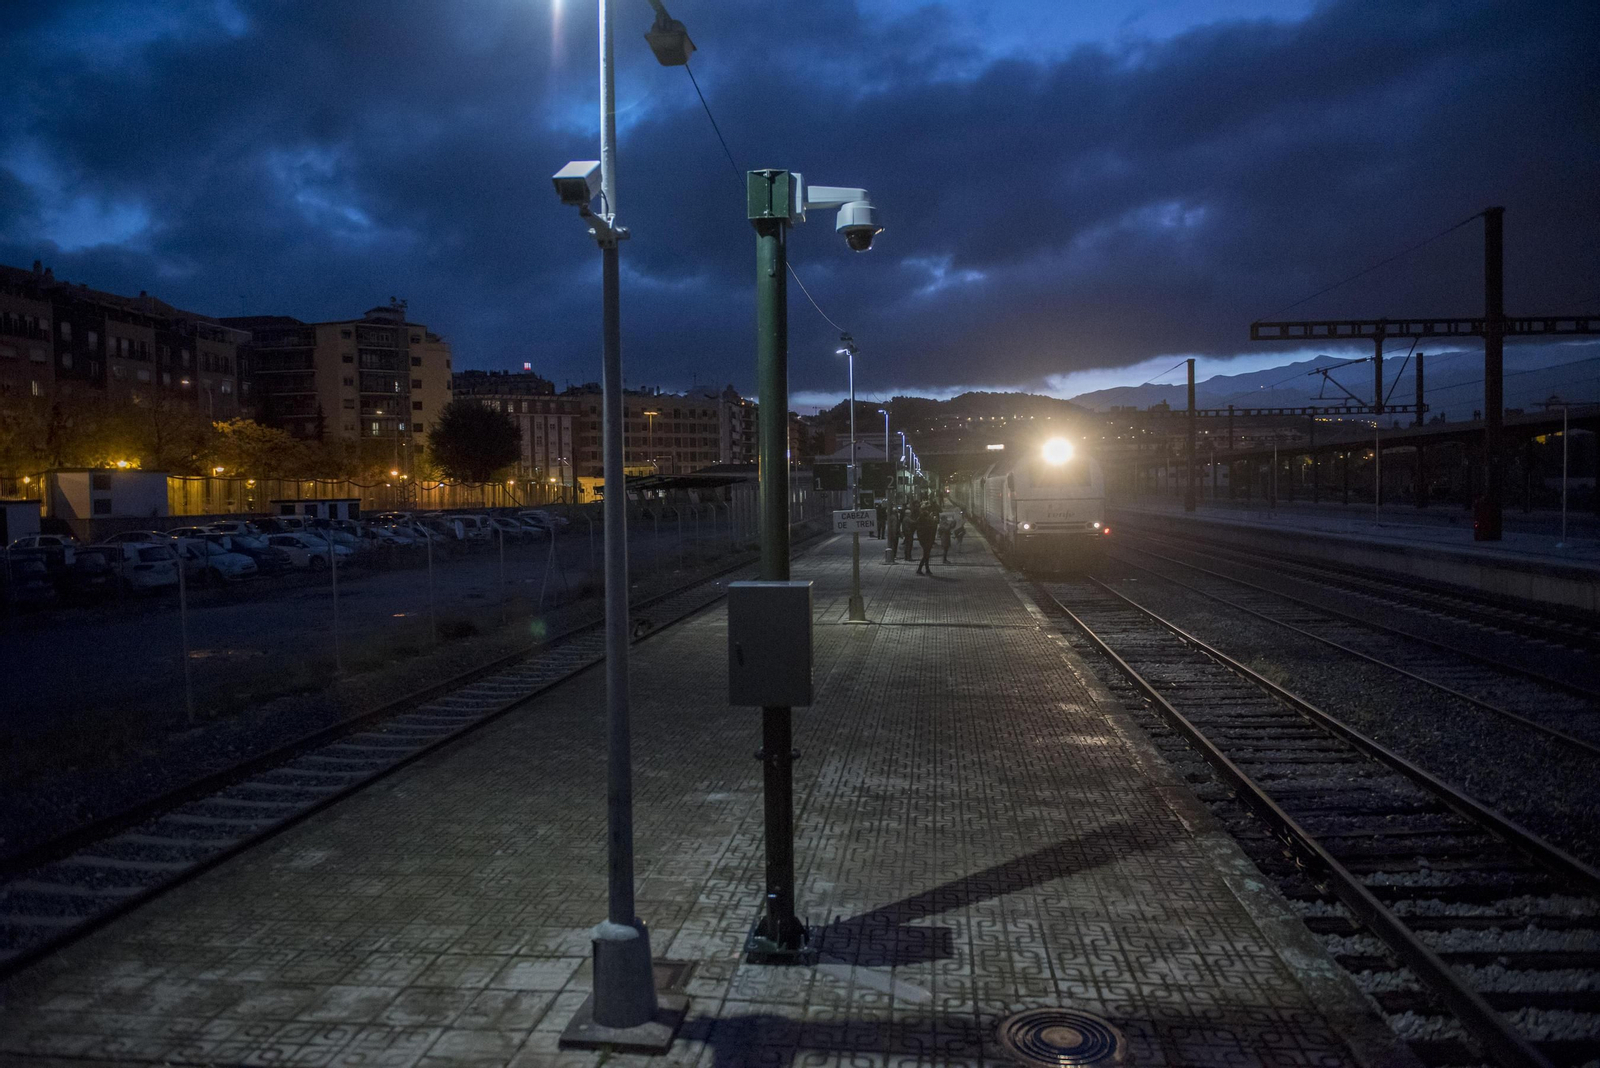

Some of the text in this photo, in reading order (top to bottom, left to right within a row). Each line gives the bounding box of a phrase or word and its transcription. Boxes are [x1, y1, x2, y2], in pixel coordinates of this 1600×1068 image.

[815, 477, 823, 490] 1
[887, 475, 895, 488] 2
[841, 511, 870, 520] CABEZA
[856, 520, 875, 528] TREN
